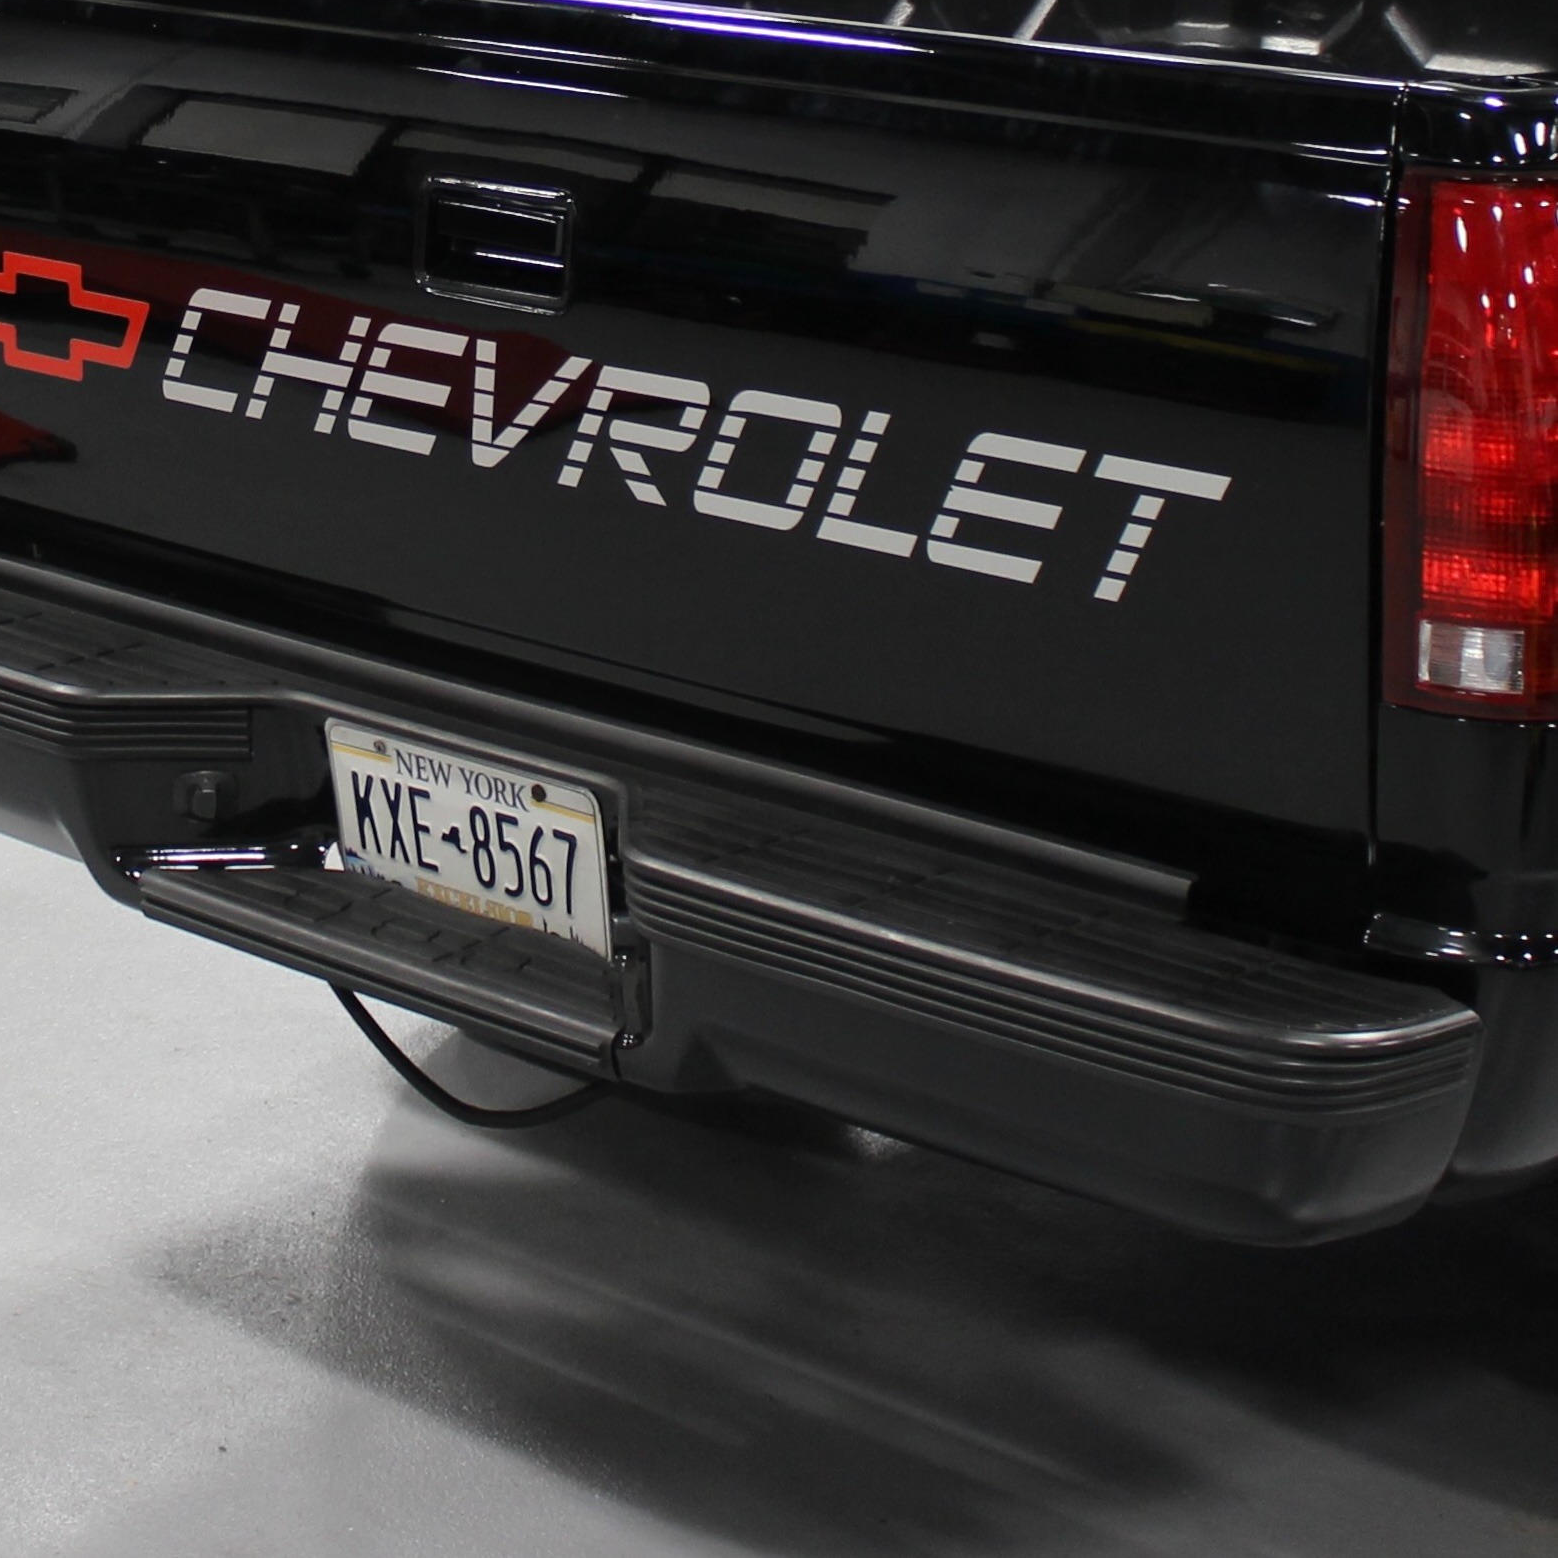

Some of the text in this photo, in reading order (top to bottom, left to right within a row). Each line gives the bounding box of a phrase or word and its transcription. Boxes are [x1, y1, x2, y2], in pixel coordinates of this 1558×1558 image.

[162, 287, 1232, 602] CHEVROLET
[351, 770, 578, 915] KXE 8567
[395, 749, 530, 813] NEW YORK
